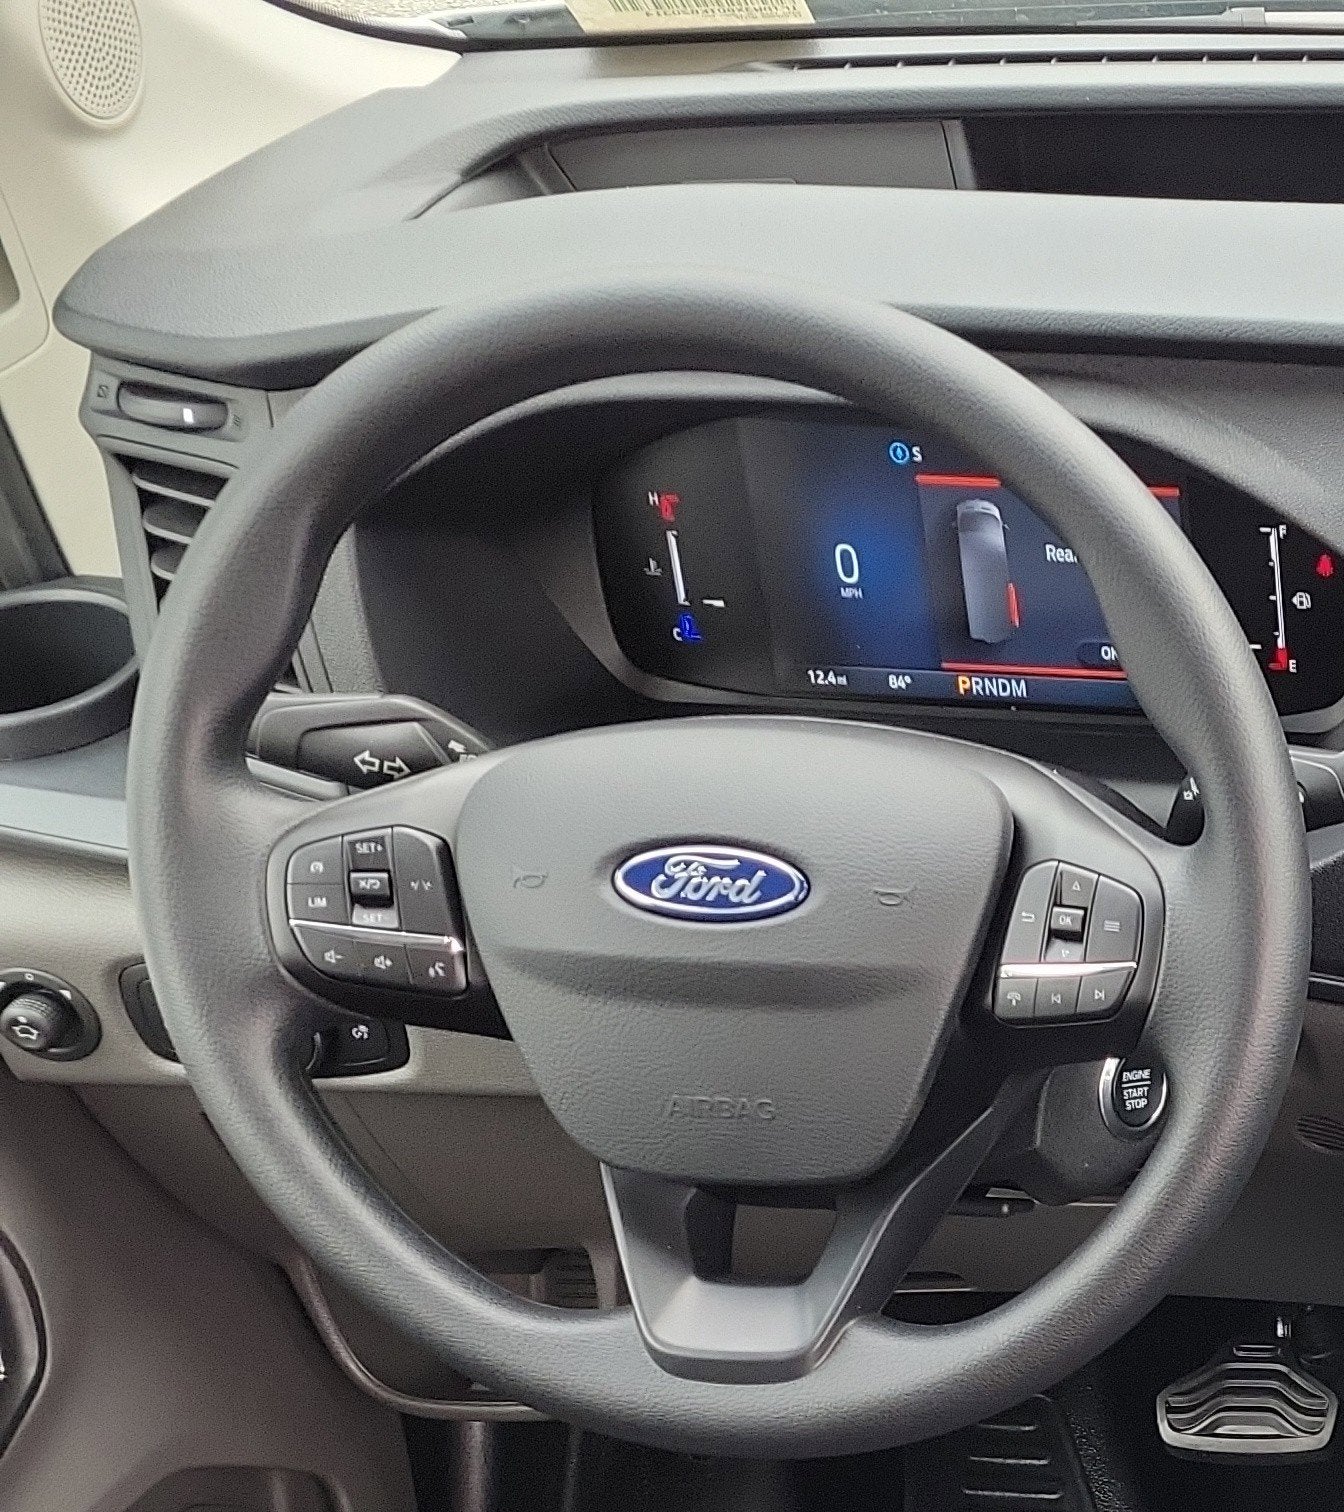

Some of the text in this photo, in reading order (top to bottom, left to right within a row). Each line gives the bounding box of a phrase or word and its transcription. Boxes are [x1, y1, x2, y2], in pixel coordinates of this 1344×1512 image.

[911, 446, 923, 463] S
[648, 491, 659, 506] H
[1045, 543, 1078, 563] Rea
[834, 543, 859, 584] 0
[840, 587, 863, 600] MPH
[1289, 659, 1297, 673] E
[651, 855, 767, 904] Ford
[1122, 1068, 1151, 1080] ENGINE
[1123, 1087, 1148, 1099] START
[1125, 1099, 1148, 1110] STOP
